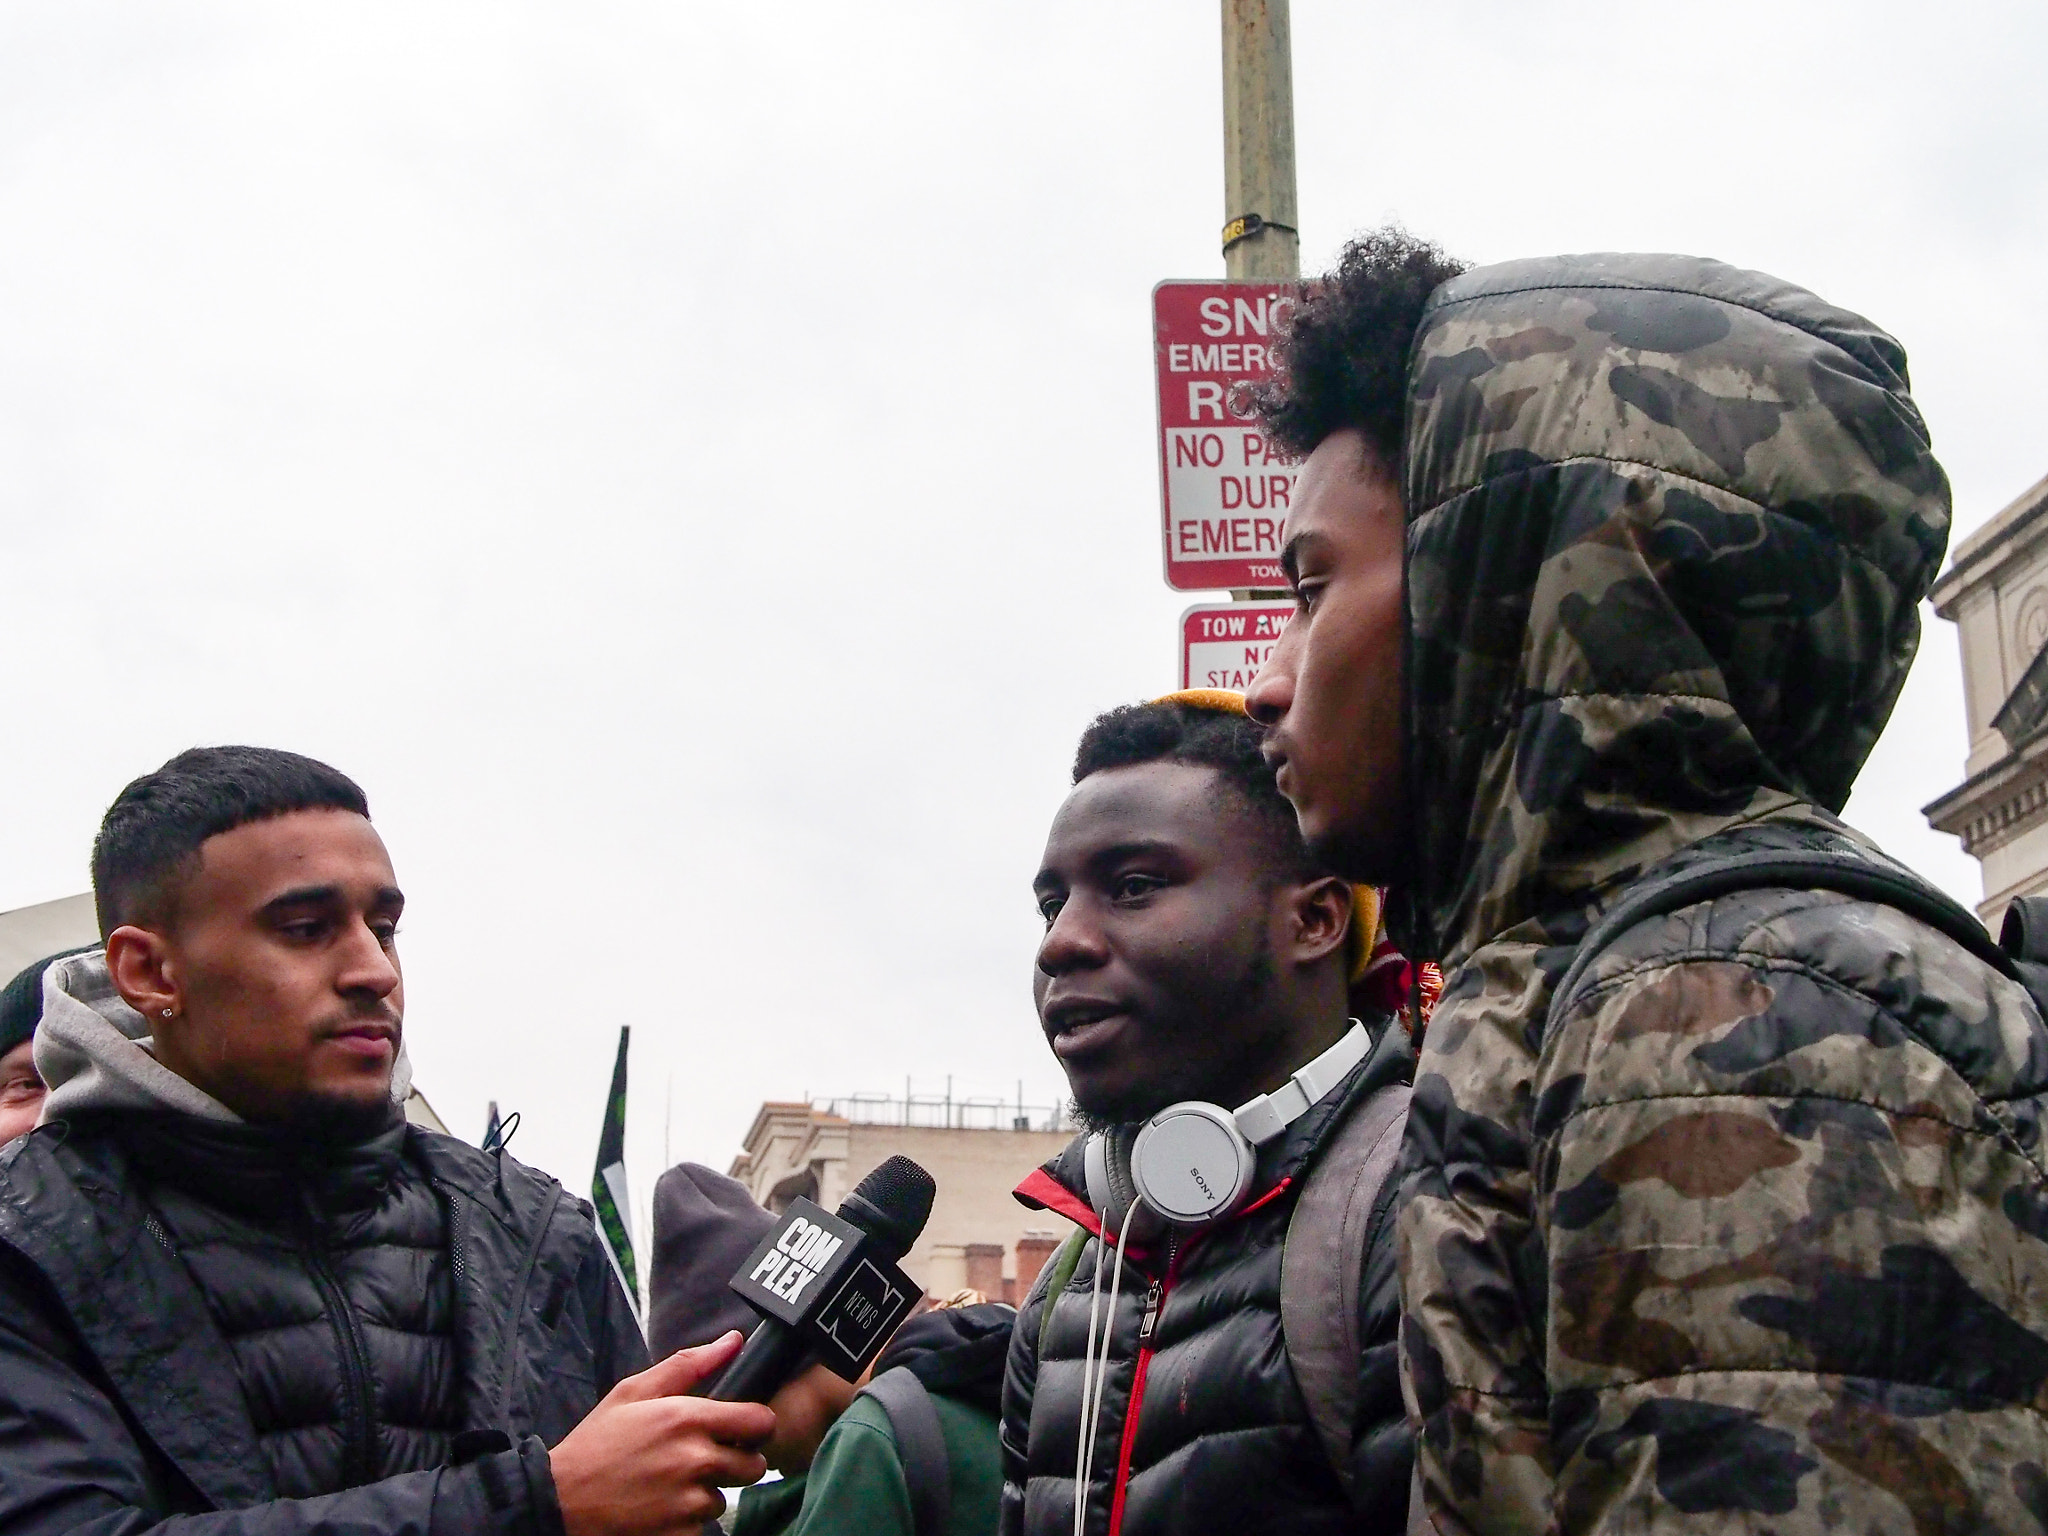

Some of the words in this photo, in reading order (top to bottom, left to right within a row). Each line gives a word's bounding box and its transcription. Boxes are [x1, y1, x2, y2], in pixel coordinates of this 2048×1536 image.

[1175, 433, 1224, 468] NO
[1220, 475, 1298, 509] DUR
[1178, 518, 1286, 553] EMER
[1248, 565, 1283, 578] TOW
[1201, 617, 1246, 637] TOW
[1190, 1167, 1215, 1201] SONY
[776, 1216, 844, 1273] COM
[749, 1248, 818, 1305] PLEX
[844, 1290, 879, 1330] NEWS
